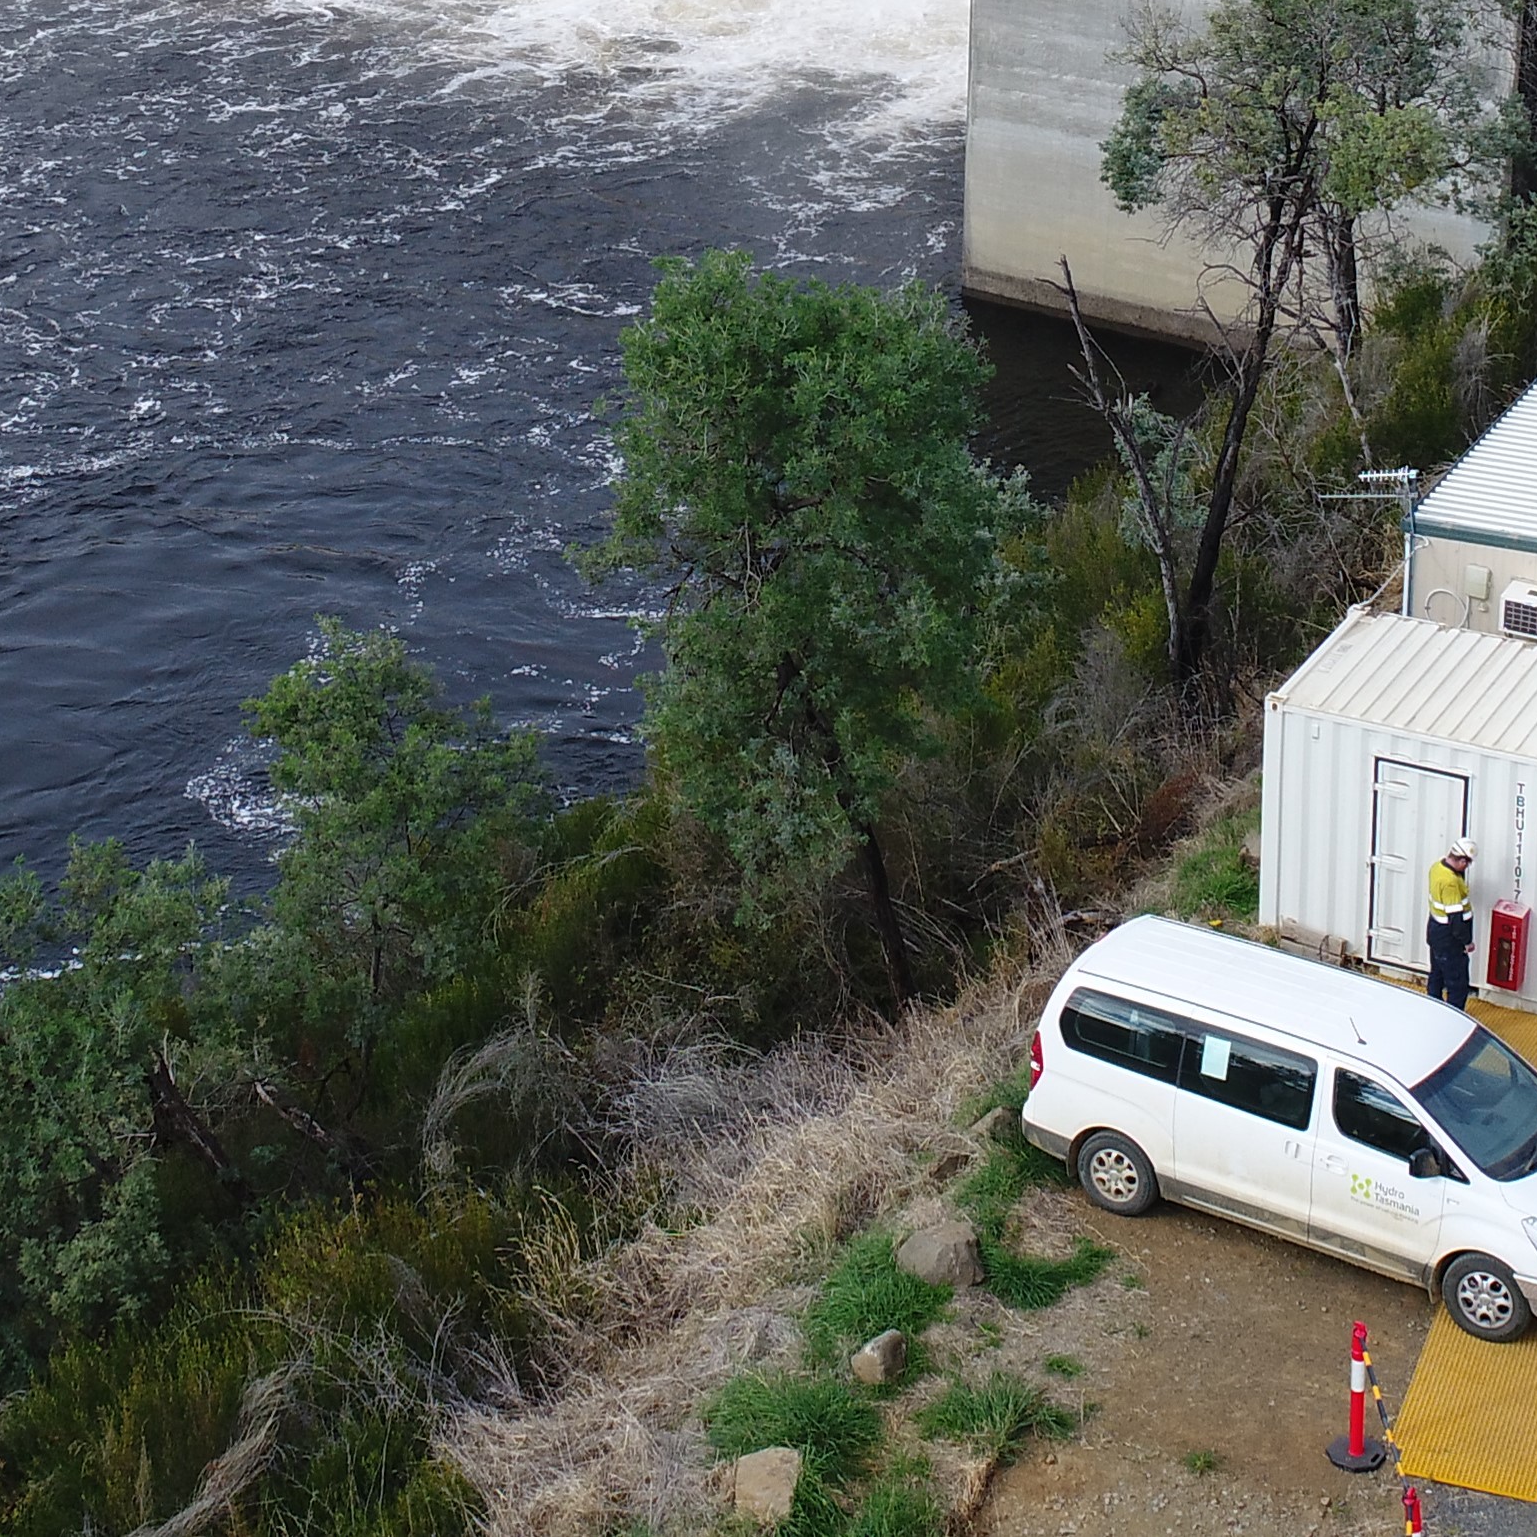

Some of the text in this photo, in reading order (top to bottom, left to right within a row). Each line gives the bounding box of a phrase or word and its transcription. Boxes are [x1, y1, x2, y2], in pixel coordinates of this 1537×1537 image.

[1515, 782, 1525, 904] TBHU111017
[1375, 1182, 1405, 1199] Hydro
[1375, 1192, 1420, 1216] Tasmania
